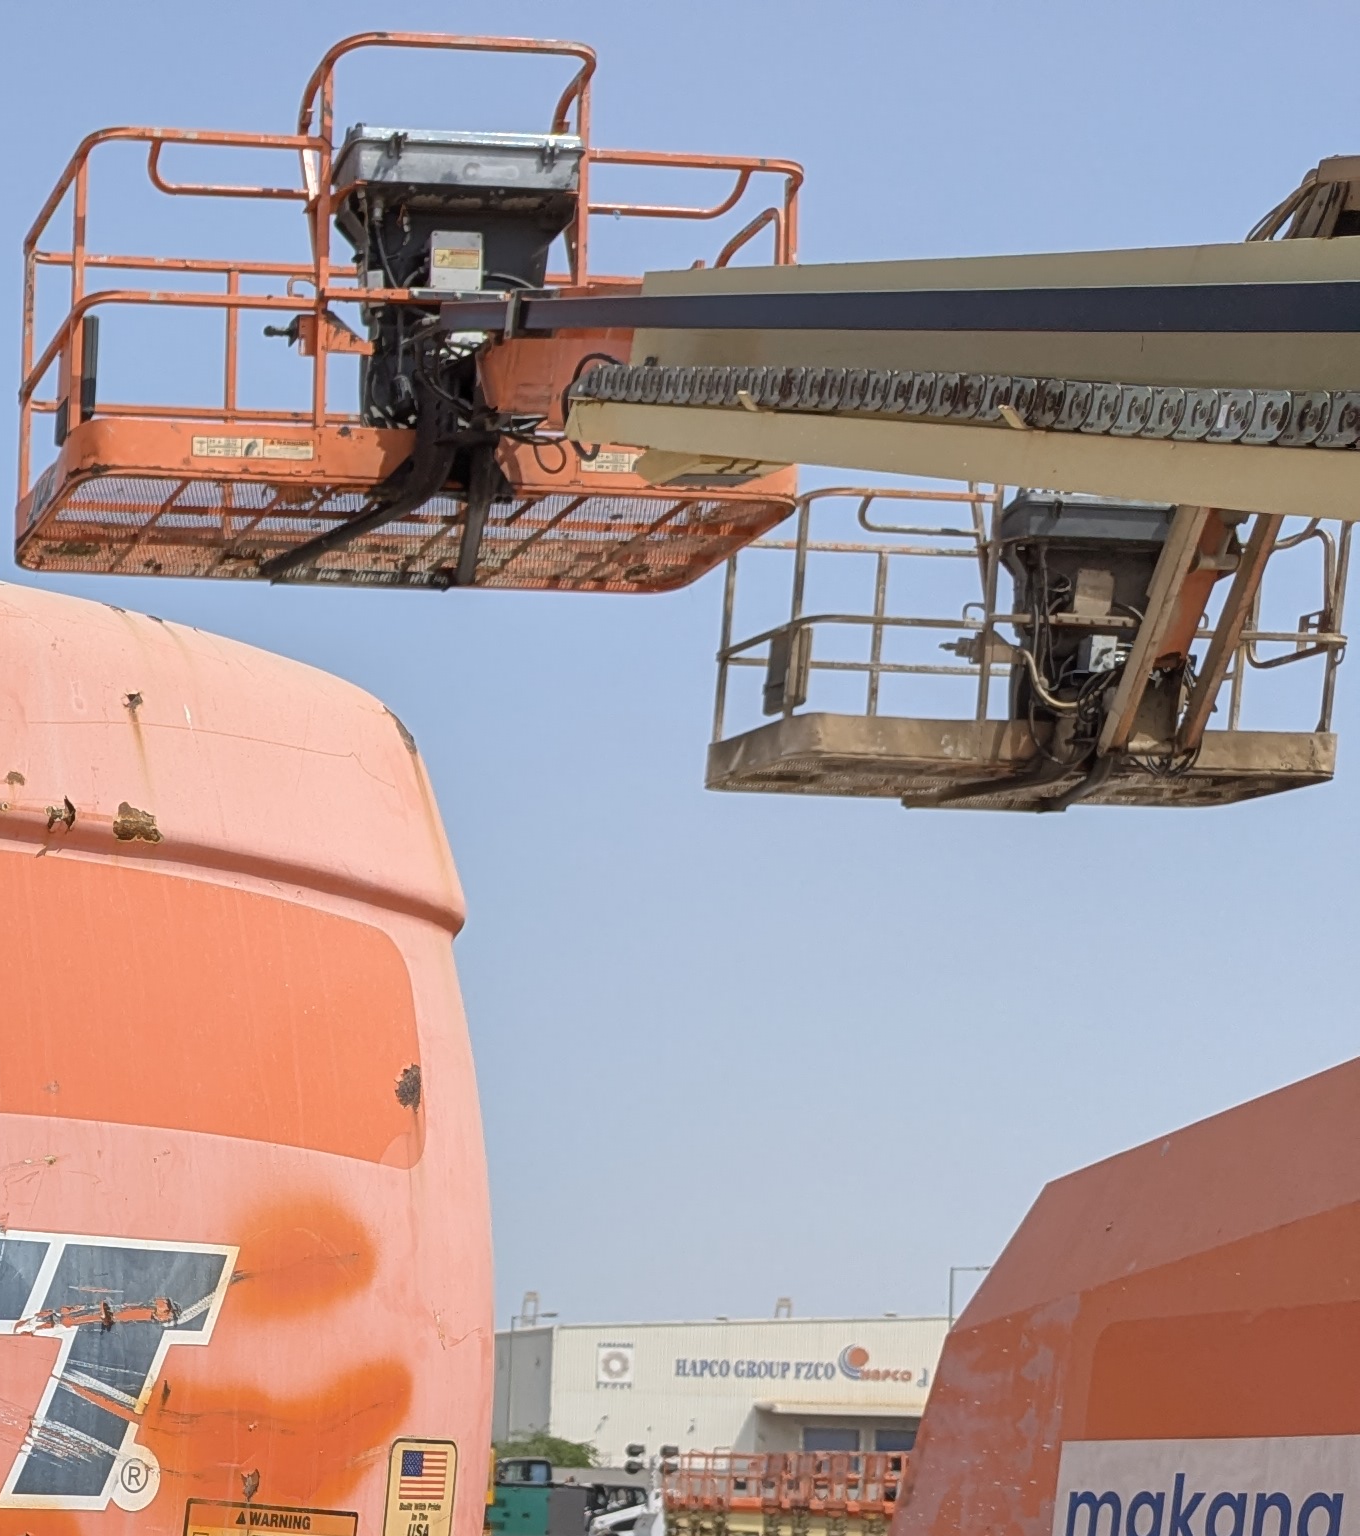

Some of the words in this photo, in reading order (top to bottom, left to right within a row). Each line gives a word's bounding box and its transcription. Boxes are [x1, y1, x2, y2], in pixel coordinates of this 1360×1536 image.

[675, 1358, 730, 1377] HAPCO
[734, 1360, 790, 1379] GROUP
[794, 1361, 836, 1381] FZCO
[249, 1511, 311, 1530] WARNING
